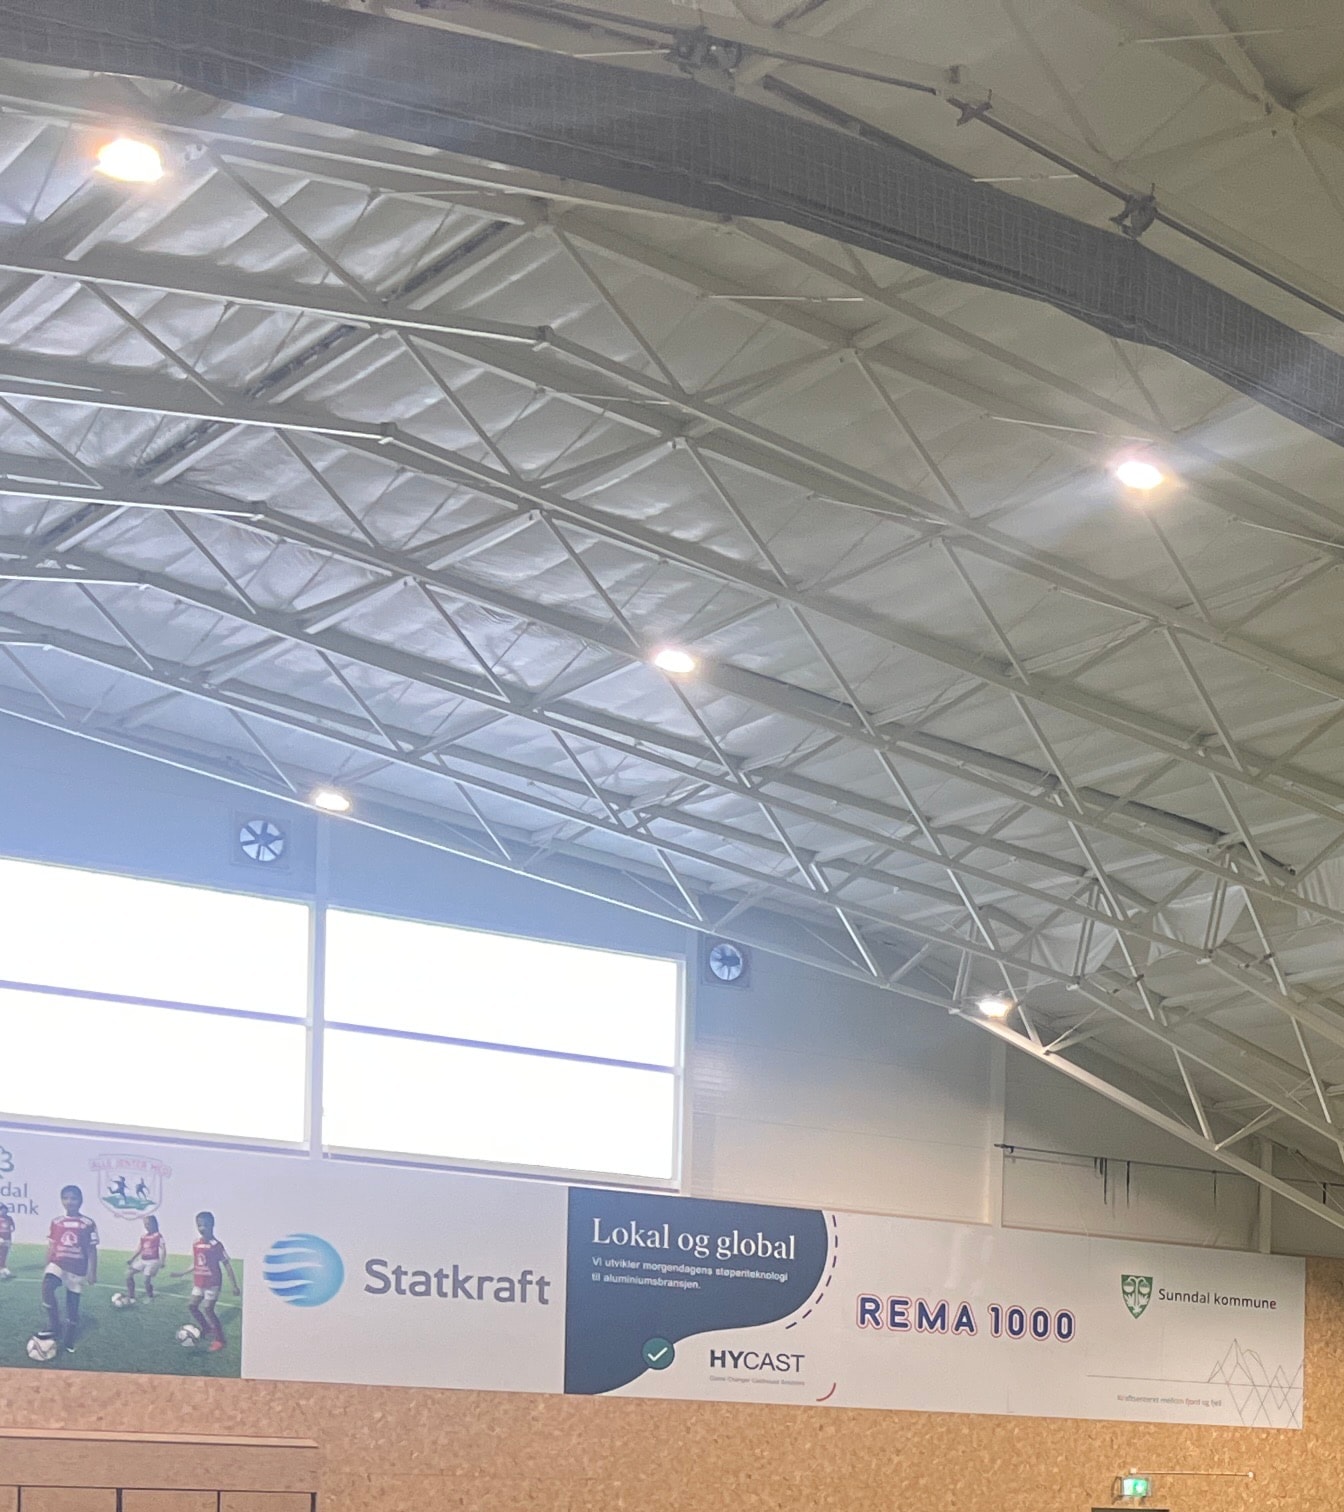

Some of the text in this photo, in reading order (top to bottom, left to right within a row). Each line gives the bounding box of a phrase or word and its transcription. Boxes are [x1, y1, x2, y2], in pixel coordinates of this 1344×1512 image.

[592, 1217, 795, 1260] Lokal og global
[592, 1273, 600, 1281] til
[605, 1258, 640, 1269] utvikler
[643, 1261, 713, 1276] morgendagens
[364, 1258, 551, 1305] Statkraft
[1158, 1288, 1277, 1310] Sunndal kommune
[856, 1293, 1075, 1343] REMA 1000
[710, 1349, 805, 1373] HYCAST
